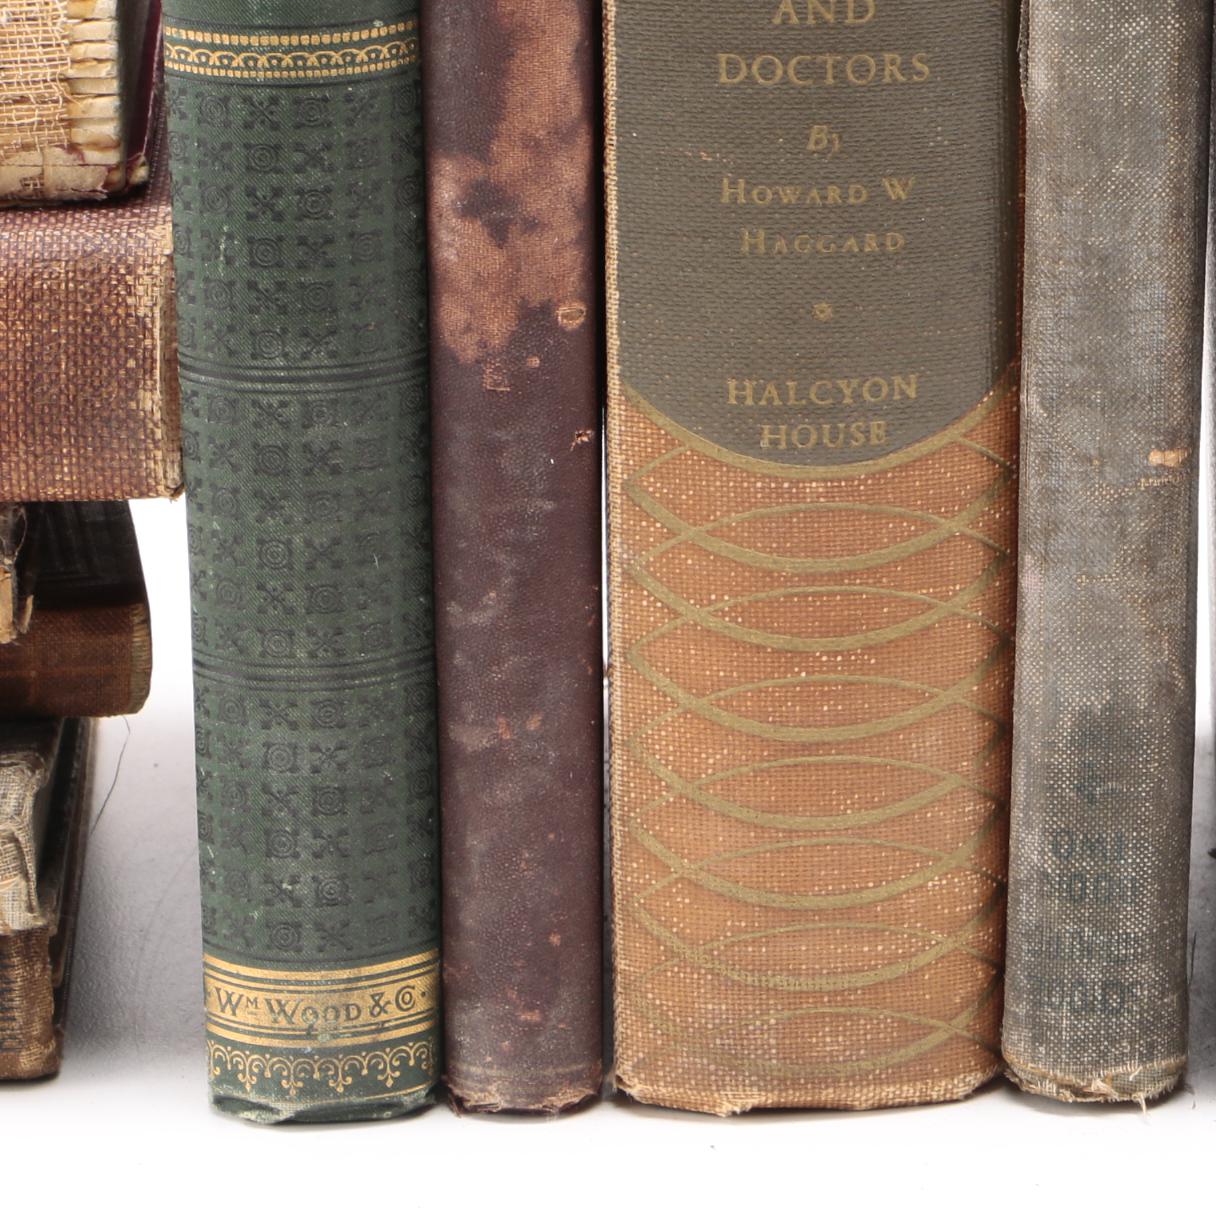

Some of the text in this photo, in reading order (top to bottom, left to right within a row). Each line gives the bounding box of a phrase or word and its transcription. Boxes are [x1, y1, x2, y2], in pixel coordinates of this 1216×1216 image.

[717, 52, 931, 84] DOCTORS
[727, 374, 919, 406] HALCYON
[761, 420, 888, 450] HOUSE
[265, 997, 362, 1025] WOOD
